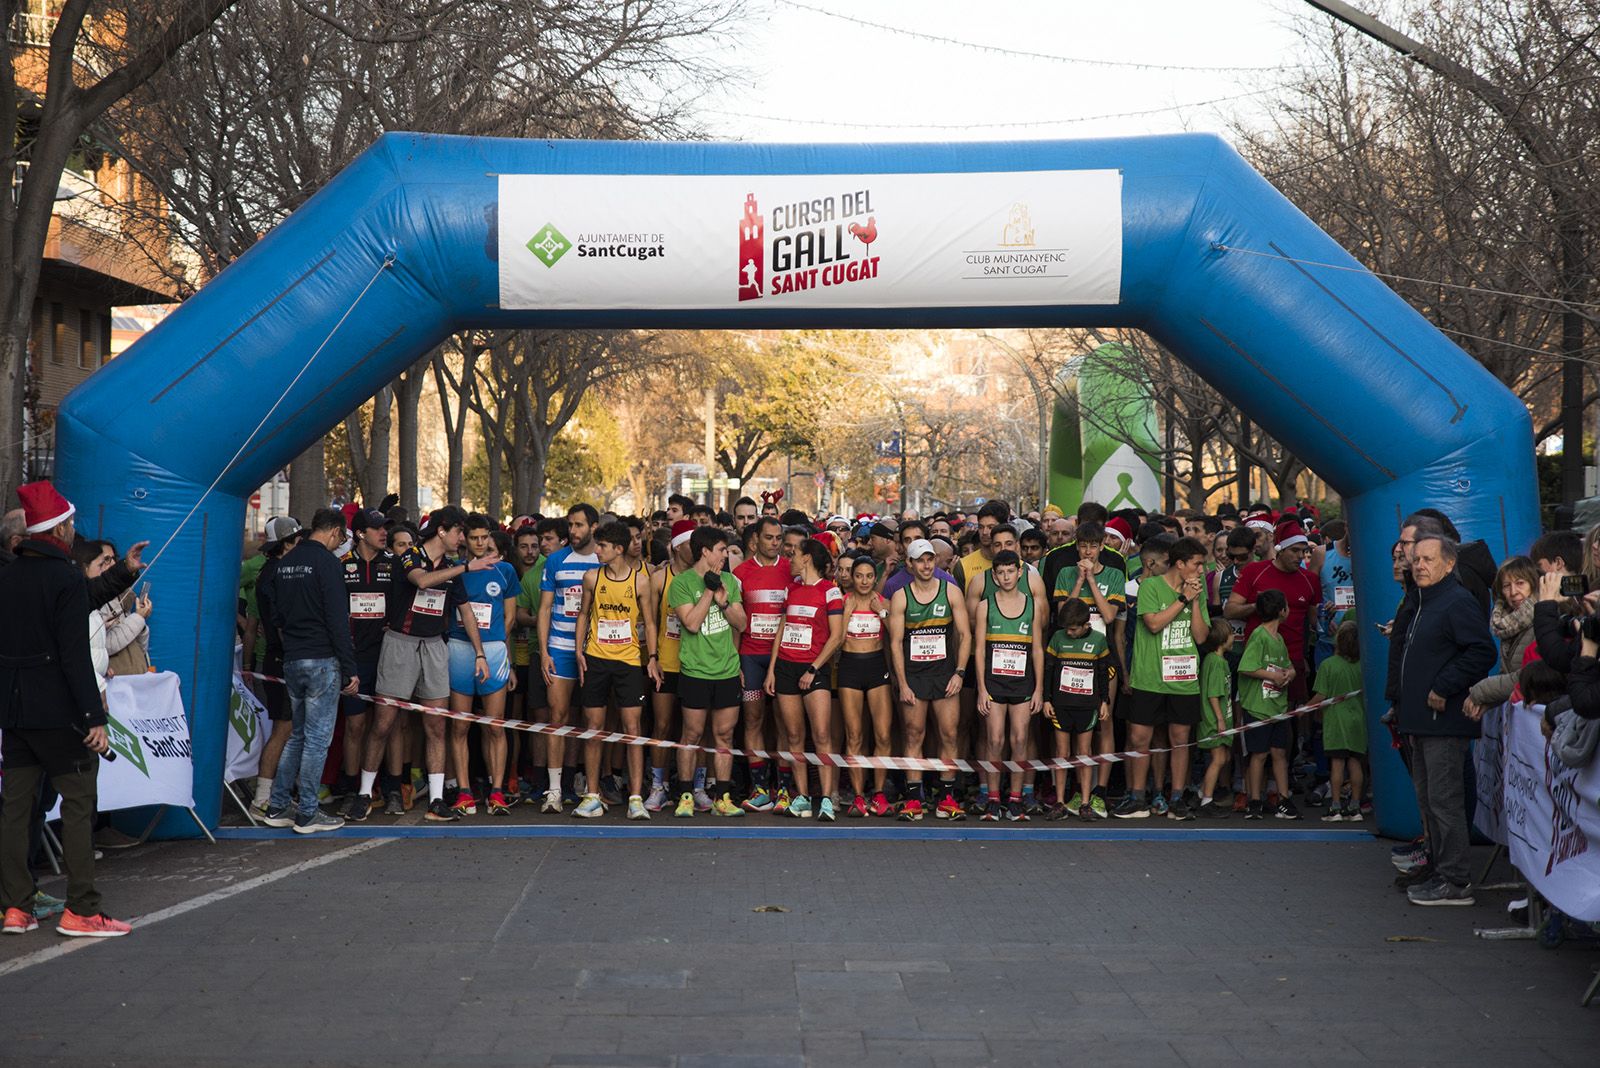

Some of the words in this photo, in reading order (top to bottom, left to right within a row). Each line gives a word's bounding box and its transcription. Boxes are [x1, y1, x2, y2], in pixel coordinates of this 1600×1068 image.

[772, 196, 835, 232] CURSA
[842, 189, 875, 218] DEL
[577, 233, 649, 243] AJUNTAMENT
[651, 233, 664, 243] DE
[577, 244, 665, 261] SantCugat
[772, 224, 850, 272] GALL
[966, 254, 990, 264] CLUB
[993, 252, 1066, 263] MUNTANYENC
[771, 268, 818, 296] SANT
[822, 256, 880, 287] CUGAT
[983, 266, 1010, 275] SANT
[1013, 265, 1047, 275] CUGAT
[142, 735, 192, 757] SantCu
